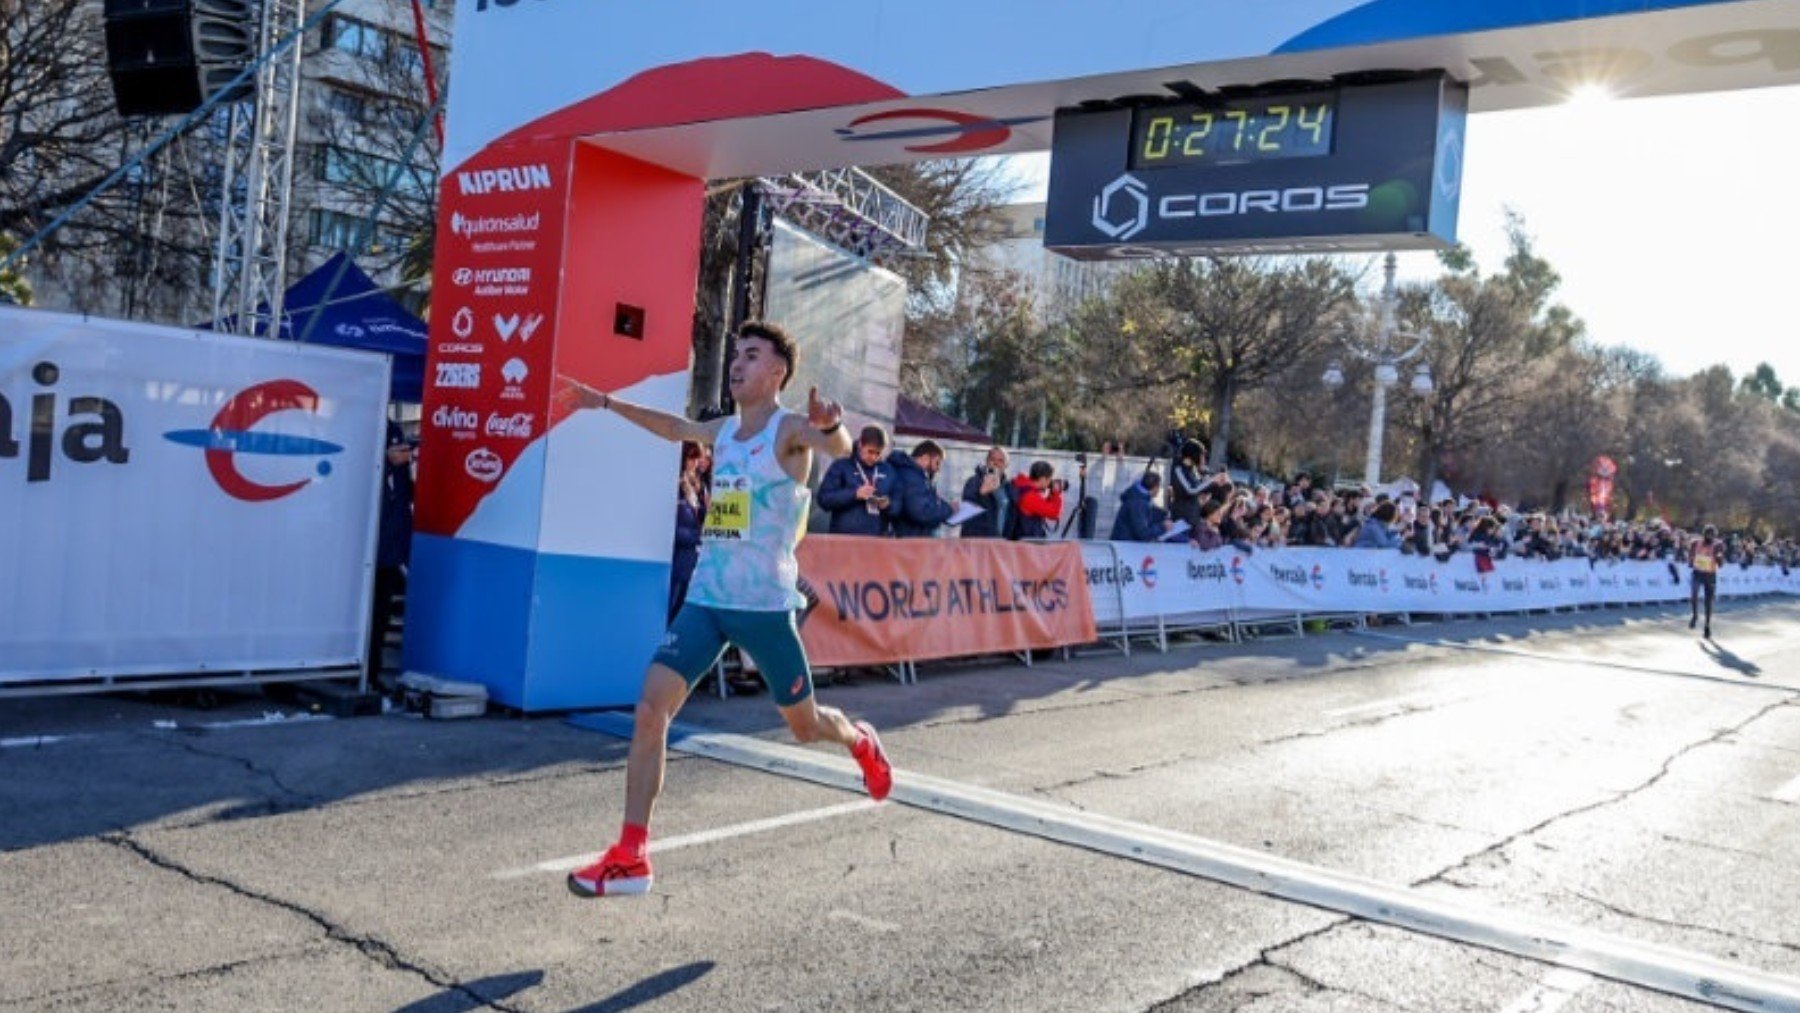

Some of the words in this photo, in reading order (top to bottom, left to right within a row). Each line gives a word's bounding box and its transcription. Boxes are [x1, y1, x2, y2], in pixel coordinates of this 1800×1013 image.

[1144, 104, 1328, 160] 0:27:24
[458, 165, 550, 195] KIPRUN
[1159, 183, 1369, 218] COROS
[475, 268, 530, 282] HYUNDAI
[827, 579, 941, 621] WORLD
[947, 579, 1068, 614] ATHLETICS
